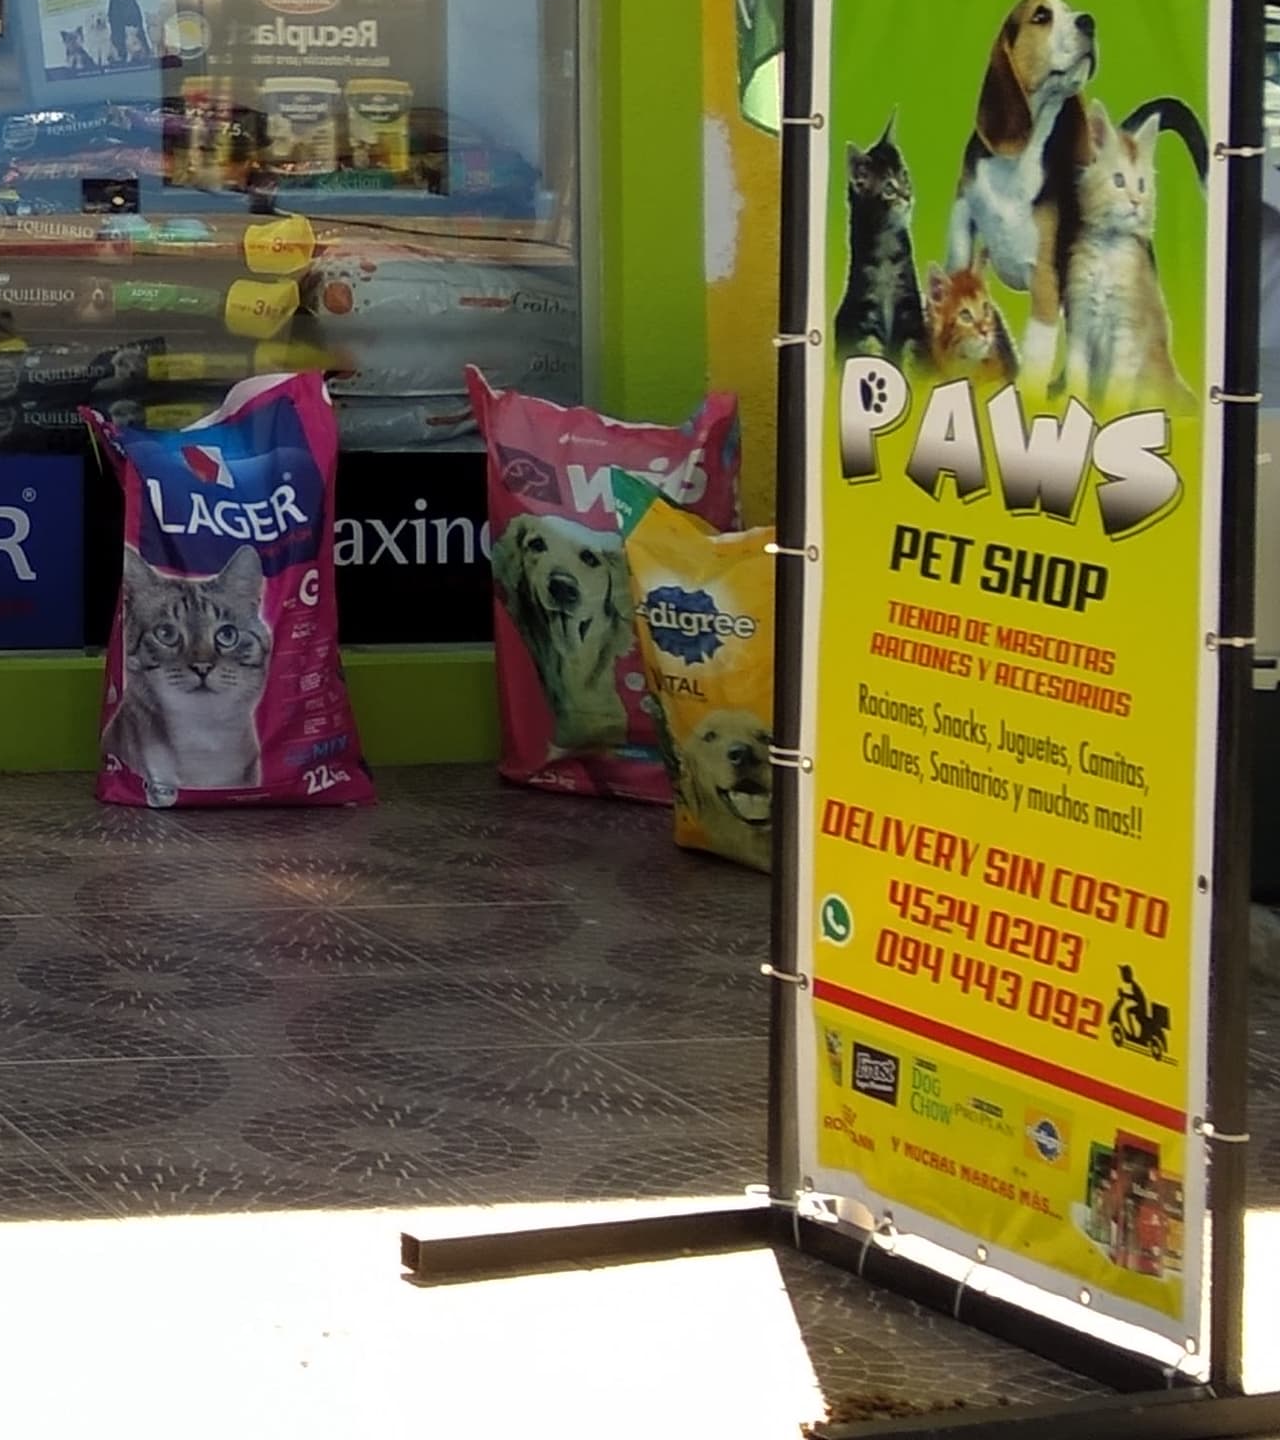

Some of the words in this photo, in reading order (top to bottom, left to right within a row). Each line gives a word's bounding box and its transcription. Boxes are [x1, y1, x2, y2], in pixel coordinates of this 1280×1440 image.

[841, 356, 1184, 541] PAWS
[146, 477, 309, 542] LAGER
[333, 498, 491, 566] axin
[889, 524, 974, 585] PET
[980, 541, 1109, 613] SHOP
[870, 632, 972, 677] RACIONES
[976, 658, 991, 681] Y
[994, 663, 1132, 718] ACCESORIOS
[888, 601, 960, 639] TIENDA
[965, 616, 992, 646] DE
[996, 623, 1116, 675] MASCOTAS
[858, 683, 928, 736] Raciones,
[933, 700, 991, 751] Snacks,
[997, 719, 1072, 775] Juguetes,
[1079, 740, 1150, 795] Camitas,
[862, 732, 924, 783] Collares,
[930, 754, 1009, 802] Sanitarios
[1013, 781, 1025, 807] y
[1027, 777, 1090, 826] muchos
[1094, 804, 1143, 840] mas!!
[821, 798, 980, 879] DELIVERY
[984, 848, 1046, 901] SIN
[1050, 868, 1171, 940] COSTO
[889, 878, 977, 942] 4524
[984, 909, 1084, 974] 0203
[875, 928, 944, 984] 094
[949, 951, 1022, 1012] 443
[1028, 980, 1106, 1040] 092
[910, 1091, 954, 1126] CHOW
[912, 1067, 941, 1098] DOG
[891, 1136, 901, 1152] Y
[904, 1142, 957, 1177] MUCHAS
[960, 1163, 1016, 1201] MARCAS
